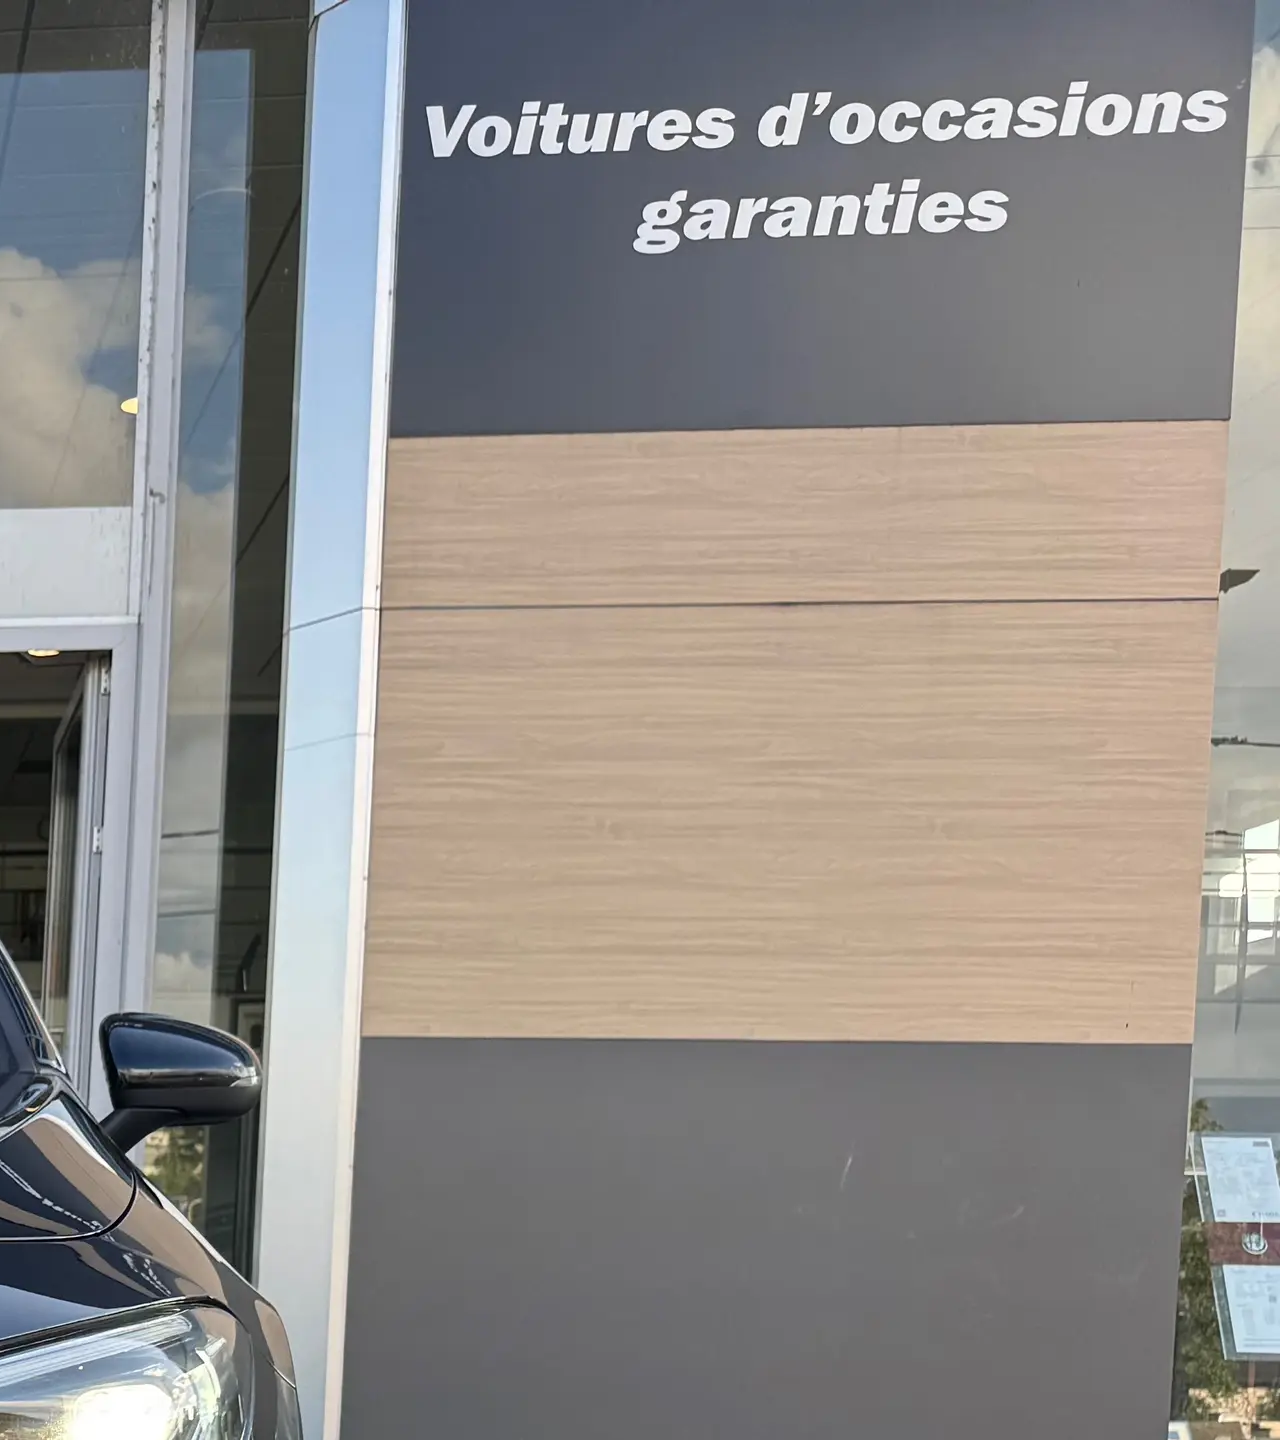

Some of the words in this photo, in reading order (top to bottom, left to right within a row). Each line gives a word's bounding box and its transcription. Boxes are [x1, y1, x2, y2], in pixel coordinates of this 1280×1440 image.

[426, 100, 736, 158] Voitures
[757, 80, 1229, 148] d'occasions
[632, 178, 1010, 254] garanties
